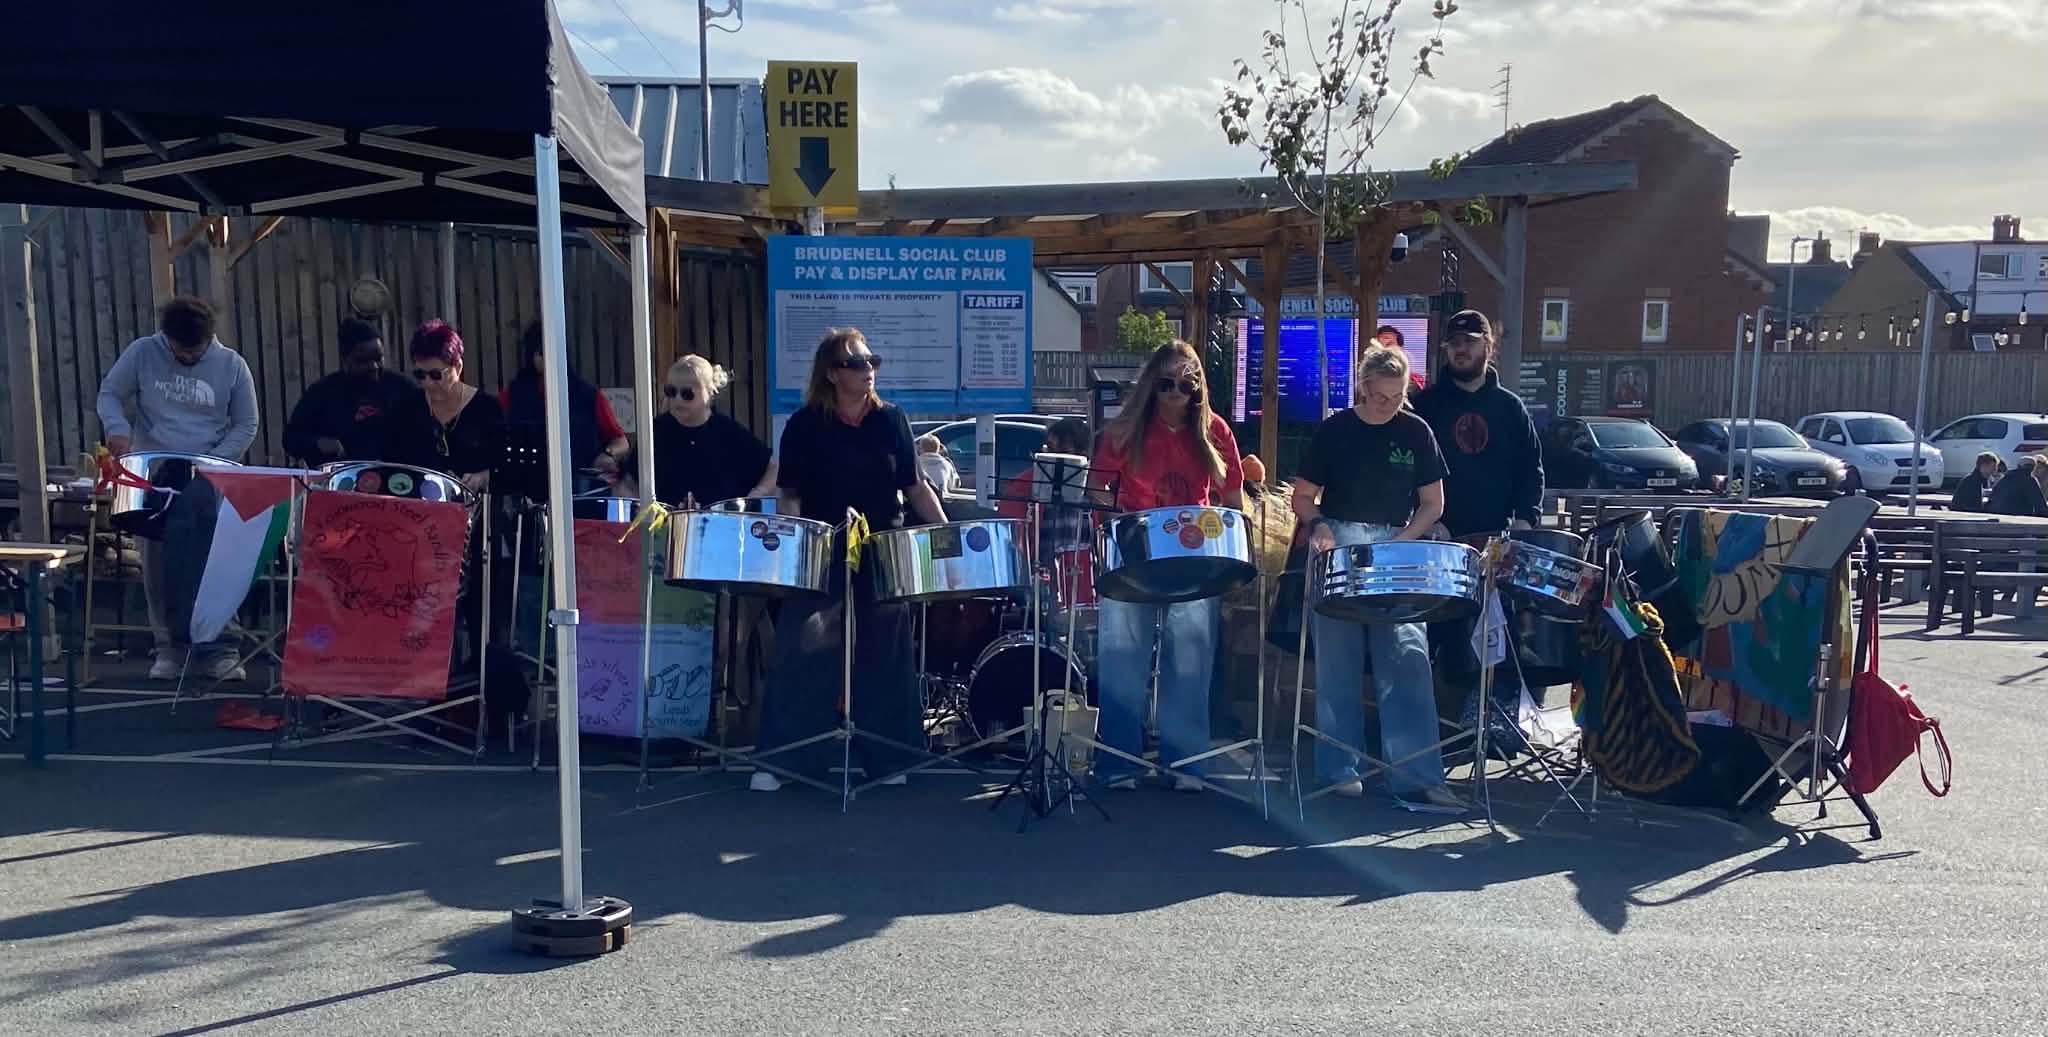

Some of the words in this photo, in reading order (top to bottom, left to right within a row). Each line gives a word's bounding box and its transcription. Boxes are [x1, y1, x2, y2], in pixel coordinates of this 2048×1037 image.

[787, 68, 839, 96] PAY
[779, 101, 849, 128] HERE
[795, 247, 894, 260] BRUDENELL
[899, 248, 959, 261] SOCIAL
[963, 248, 1007, 262] CLUB
[795, 266, 825, 280] PAY
[830, 266, 844, 280] &
[849, 266, 919, 280] DISPLAY
[923, 267, 956, 280] CAR
[961, 267, 1007, 280] PARK
[791, 293, 812, 301] THIS
[813, 293, 839, 301] LAND
[841, 293, 851, 301] IS
[852, 293, 892, 301] PRIVATE
[894, 293, 943, 301] PROPERTY
[967, 295, 1021, 308] TARIFF
[1556, 368, 1568, 417] COLOUR
